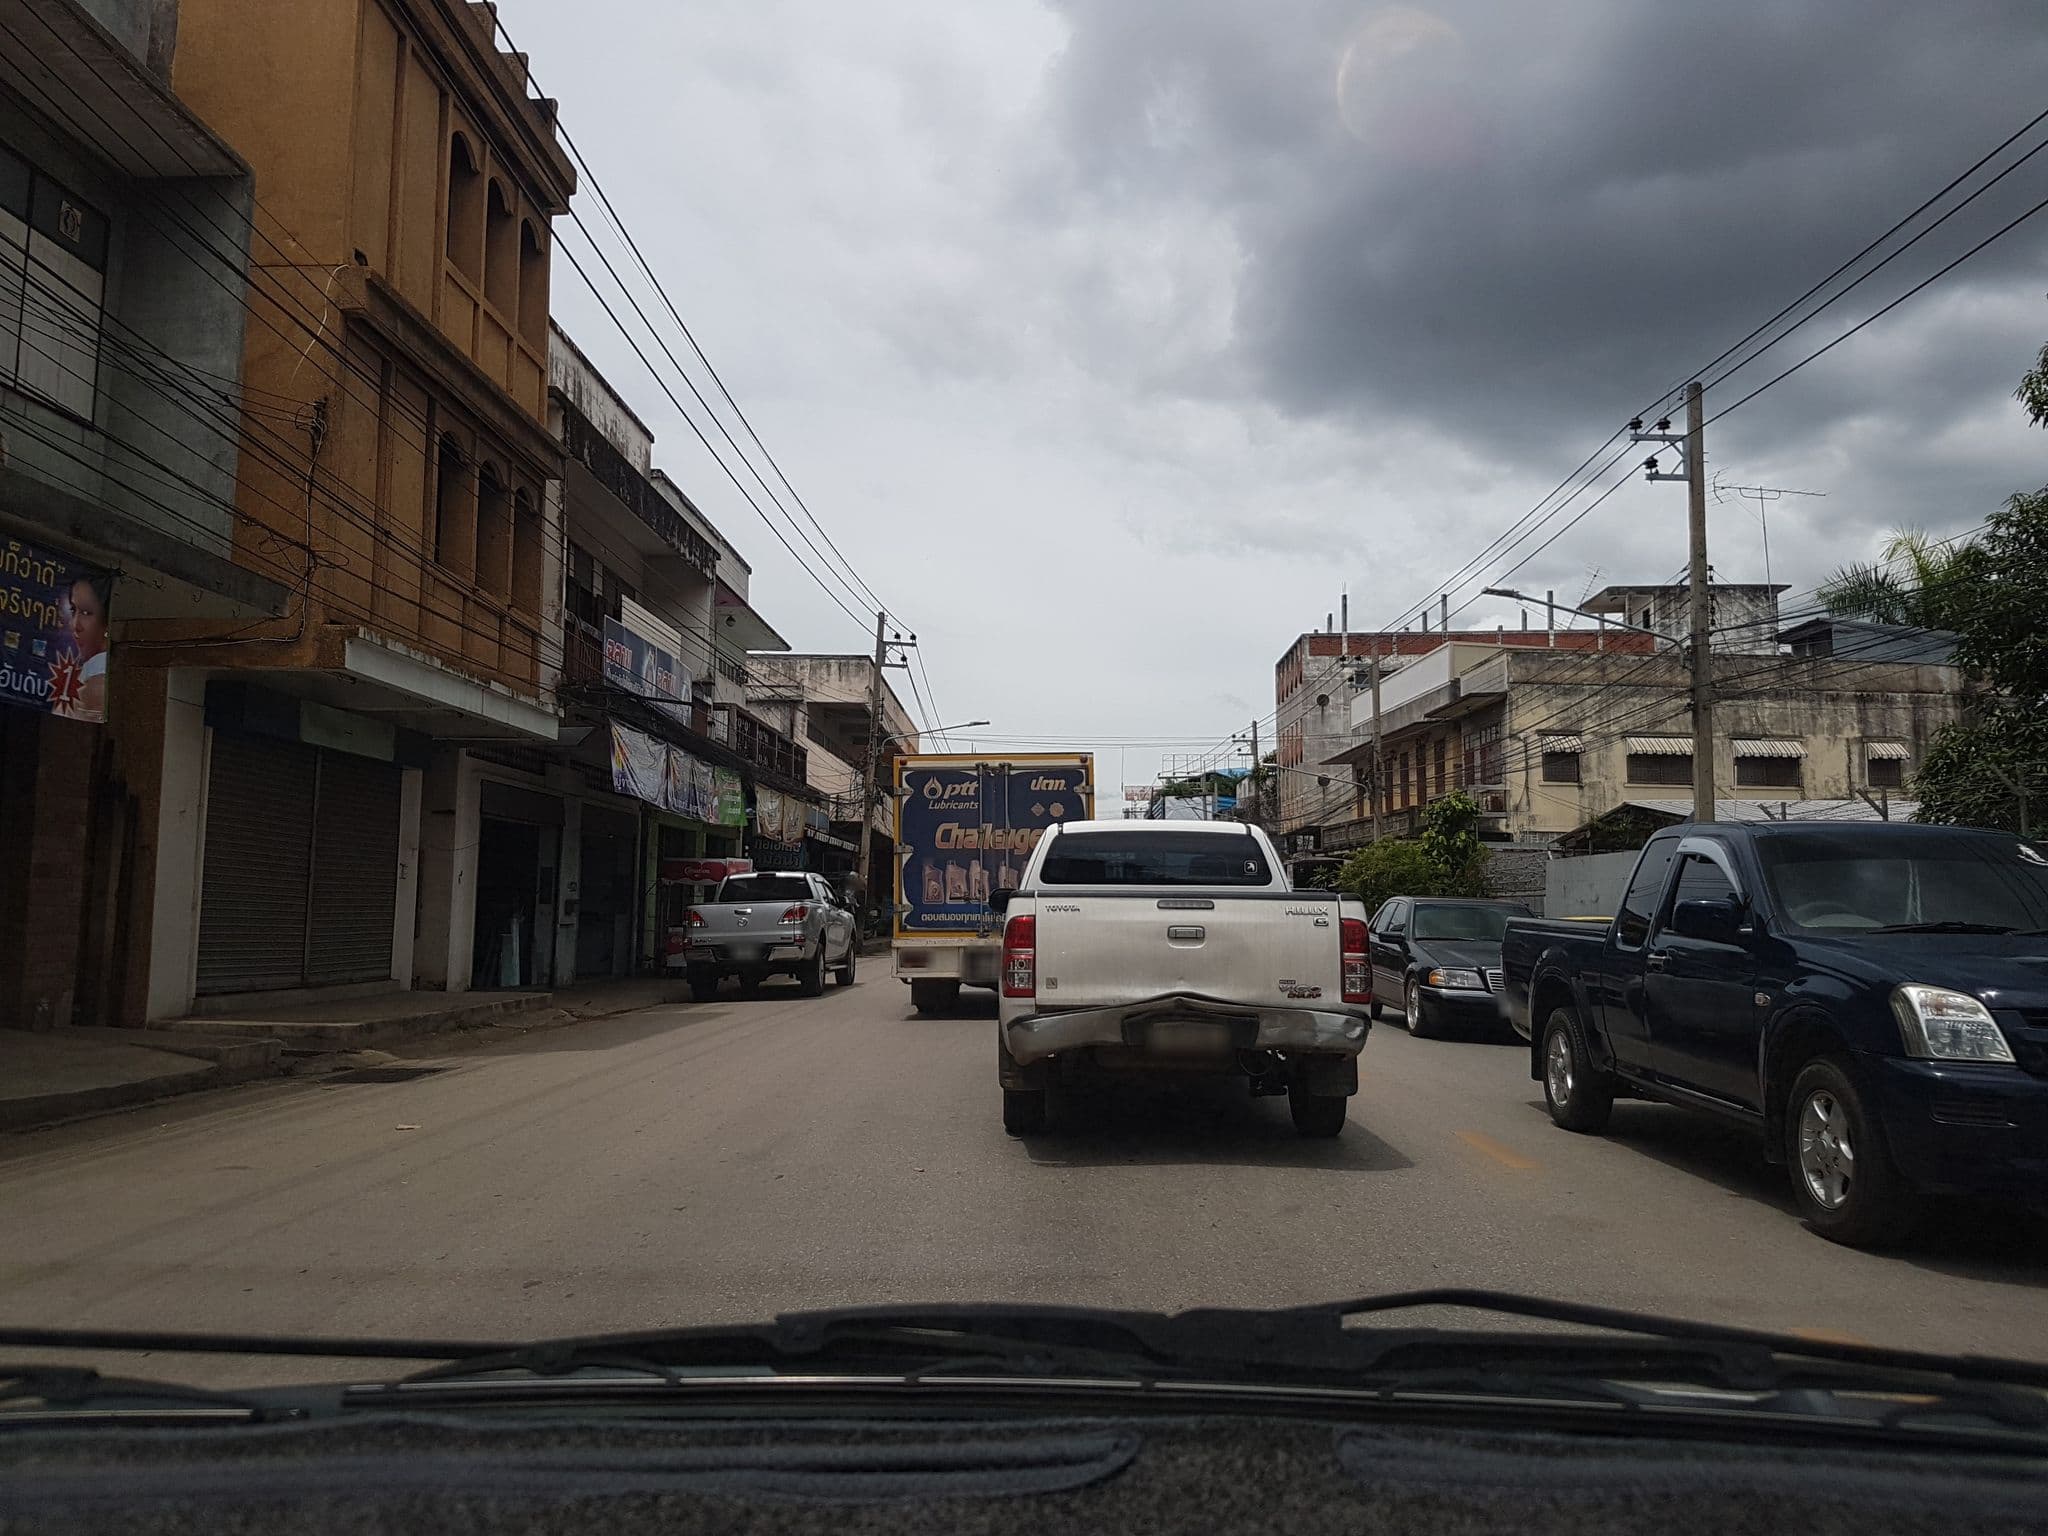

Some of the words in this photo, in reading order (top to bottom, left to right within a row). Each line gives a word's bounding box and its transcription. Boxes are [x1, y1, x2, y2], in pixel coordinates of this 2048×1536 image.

[0, 662, 48, 697] อันดับ
[59, 665, 74, 701] 1
[943, 781, 979, 800] ptt
[928, 799, 979, 810] Lubricants
[1045, 903, 1080, 912] TOYOTA
[1285, 905, 1328, 916] HILUX
[1313, 917, 1329, 927] G
